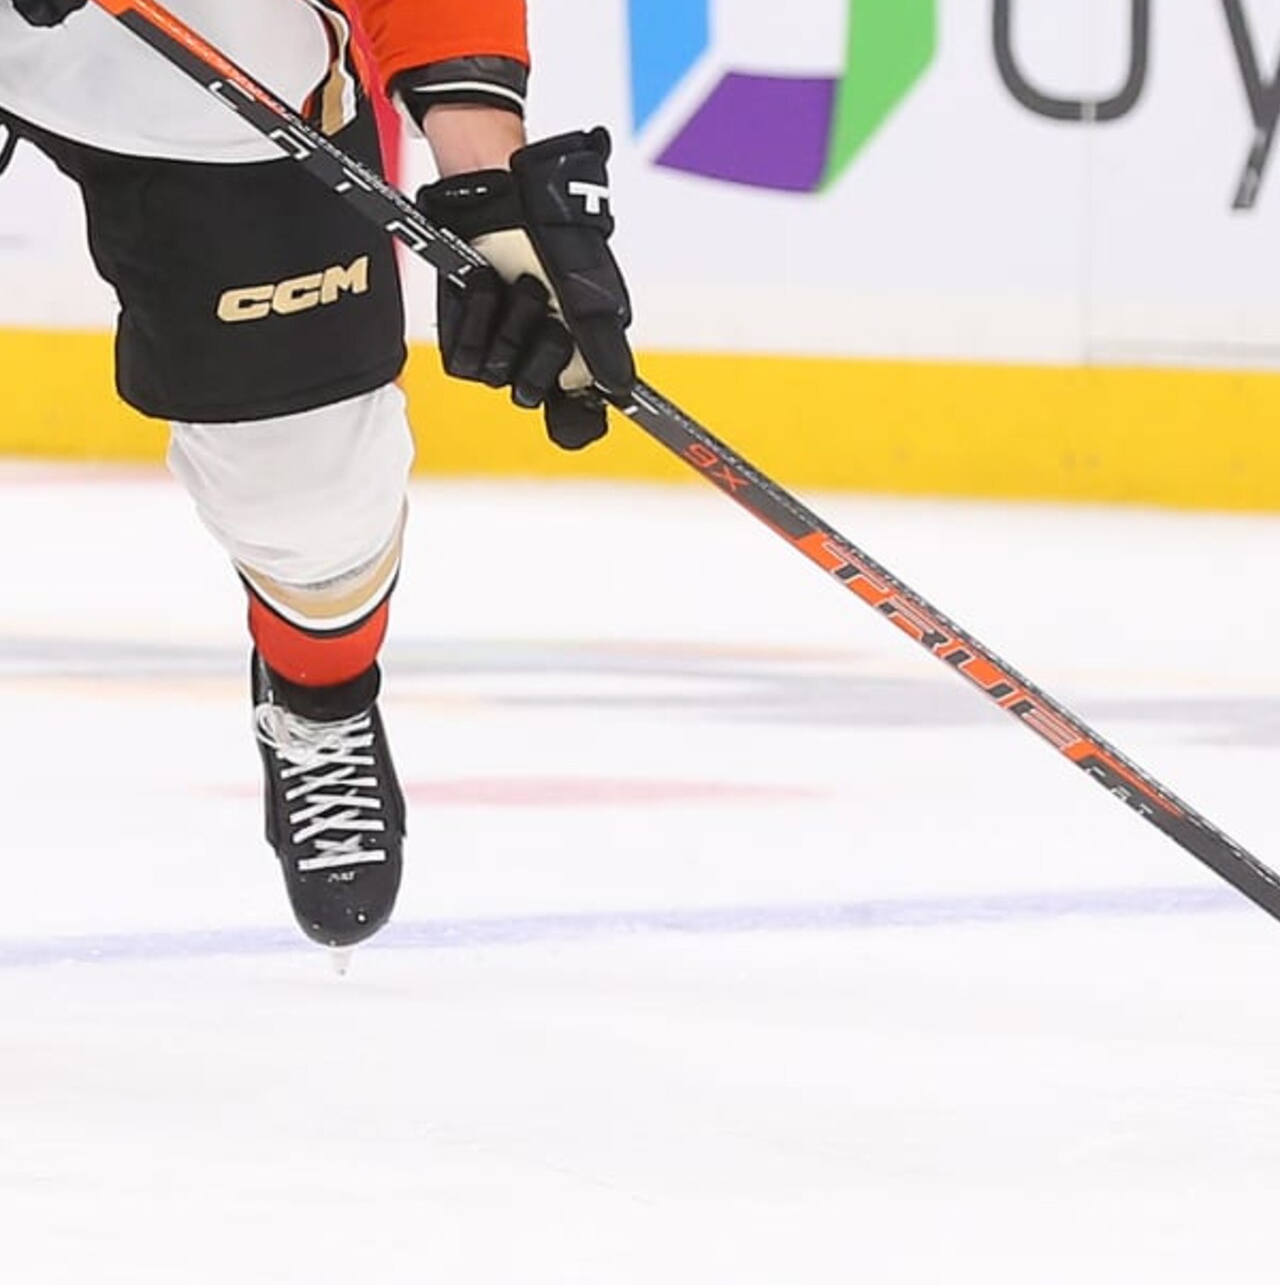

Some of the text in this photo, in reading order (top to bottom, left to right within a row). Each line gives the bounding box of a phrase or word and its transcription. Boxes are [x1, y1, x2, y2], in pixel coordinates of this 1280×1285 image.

[217, 255, 369, 322] CCM
[684, 443, 749, 492] 9X
[821, 537, 1084, 752] TRUE
